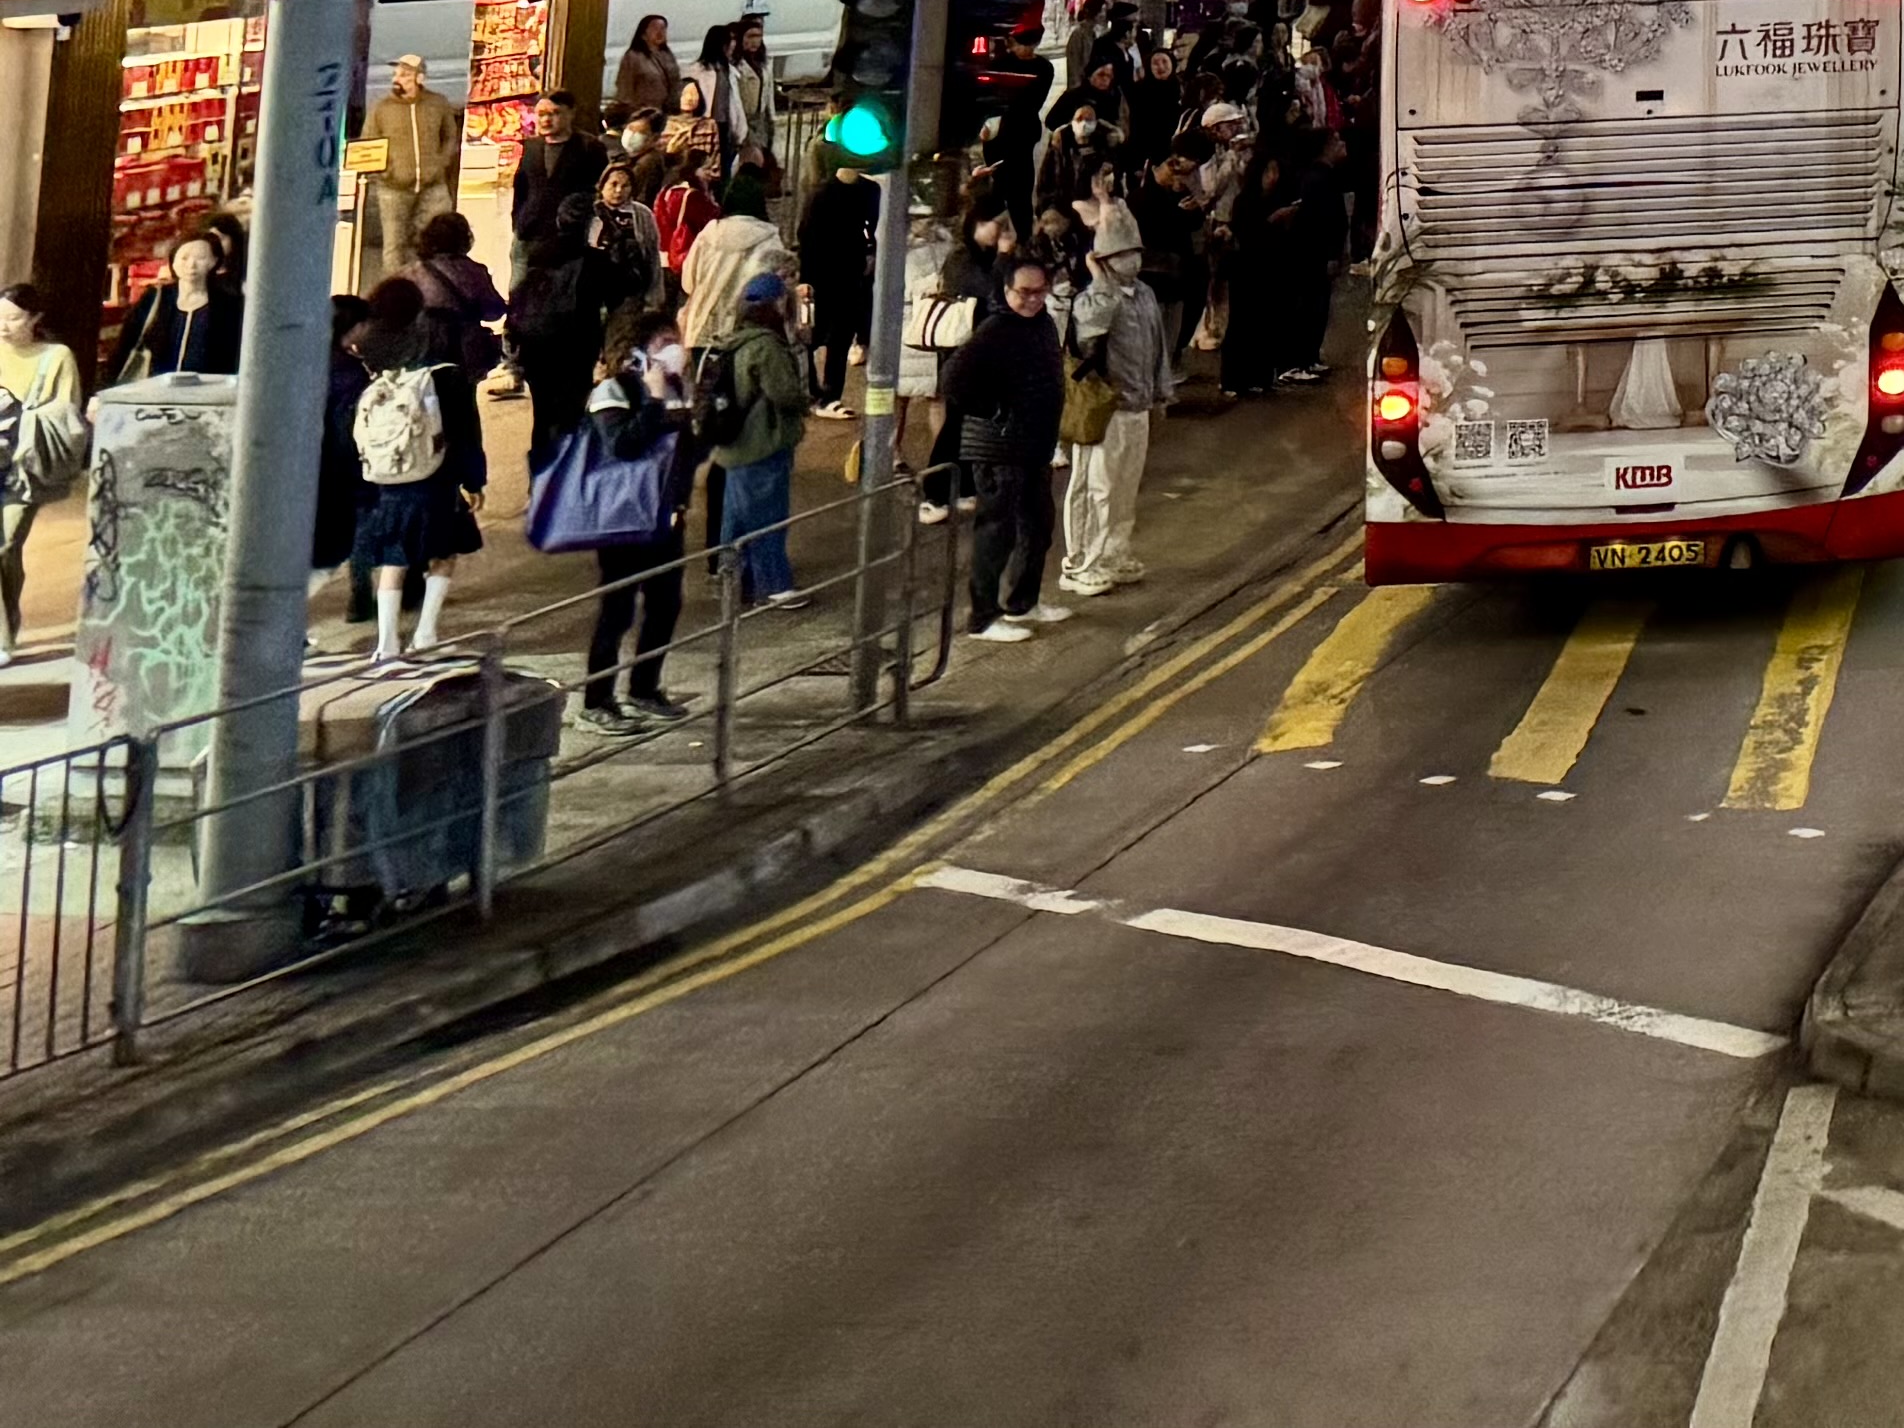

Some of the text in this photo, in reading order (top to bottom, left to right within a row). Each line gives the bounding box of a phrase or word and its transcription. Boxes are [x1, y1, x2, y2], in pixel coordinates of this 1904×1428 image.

[1716, 18, 1880, 62] 六福珠寶
[1716, 58, 1878, 81] LUKFOOK JEWELLERY
[1615, 464, 1673, 490] KMB
[1594, 543, 1700, 569] VN 2405
